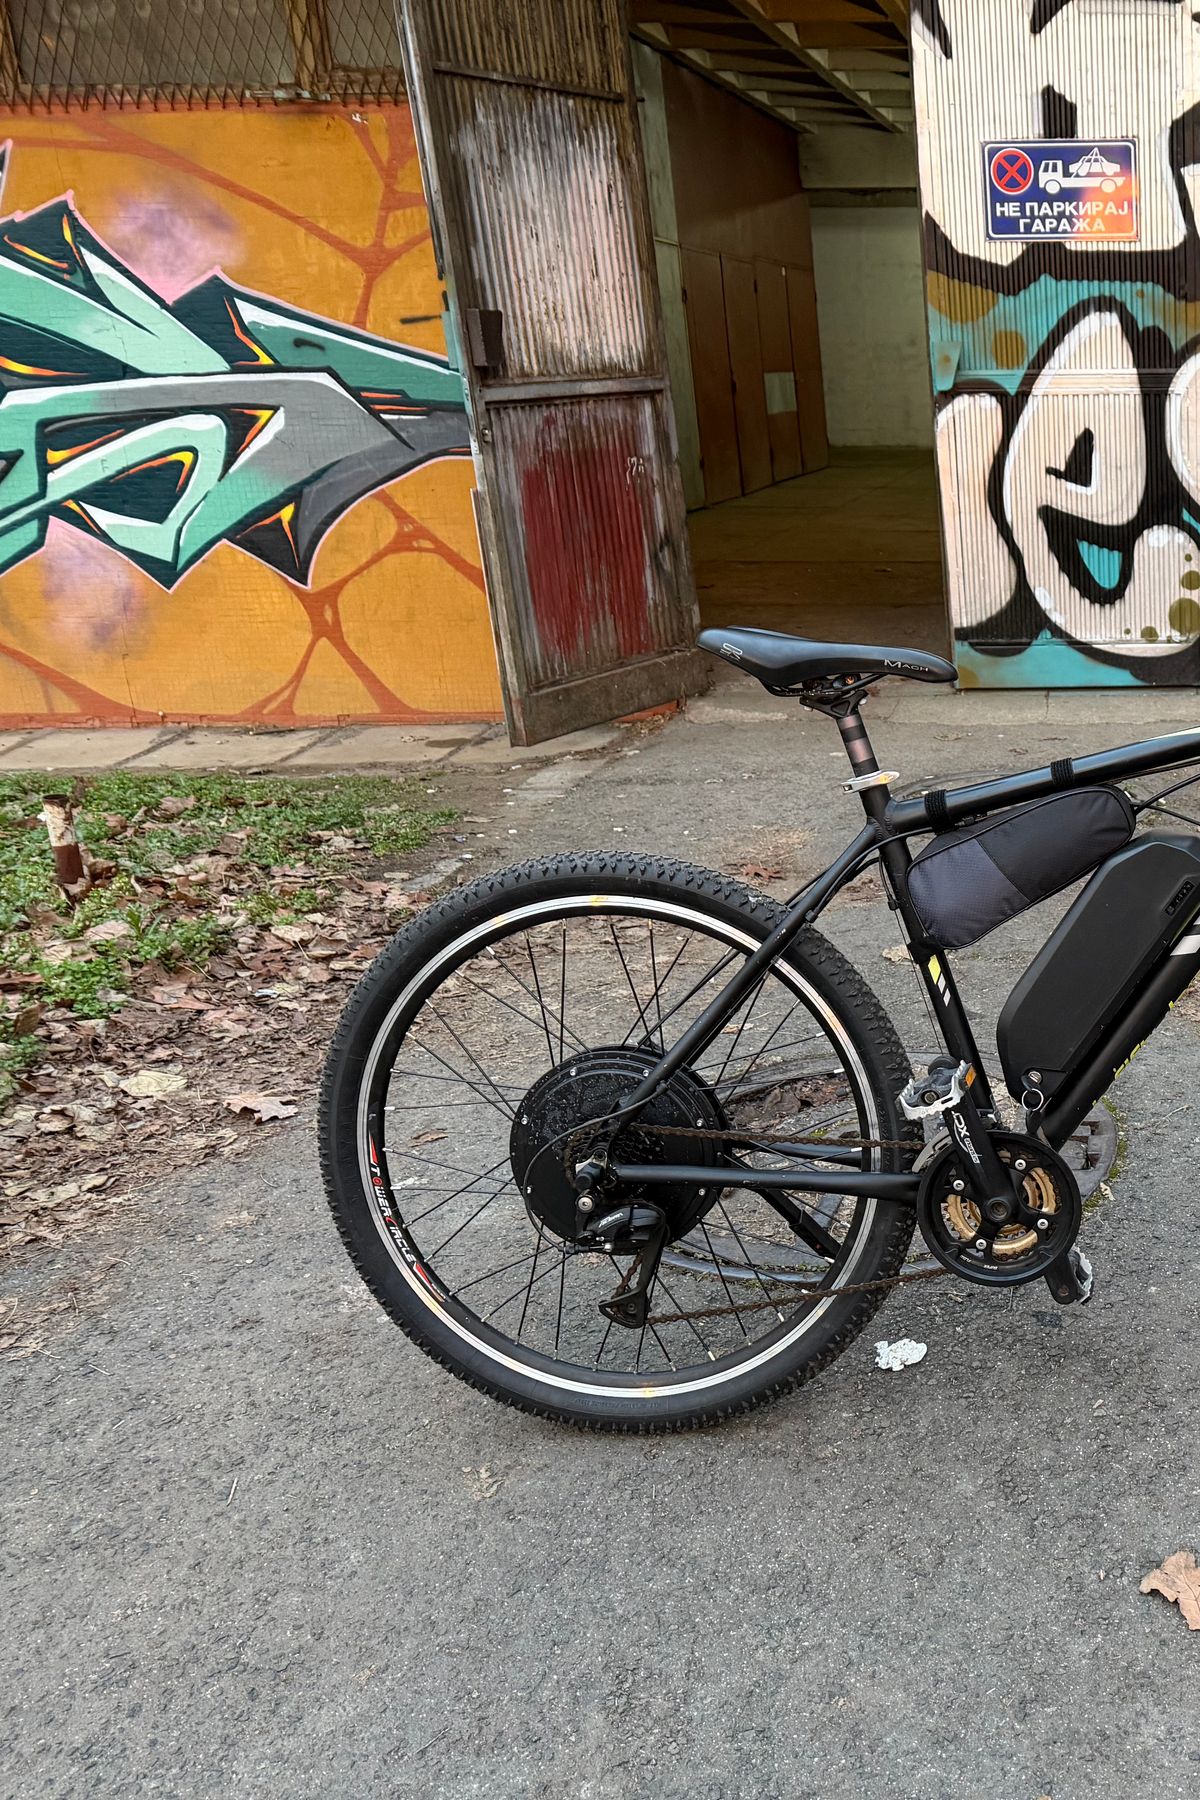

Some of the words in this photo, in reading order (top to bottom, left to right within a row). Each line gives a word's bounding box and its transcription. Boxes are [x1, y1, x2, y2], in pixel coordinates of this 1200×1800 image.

[995, 202, 1021, 217] НЕ
[1026, 201, 1128, 217] ПАРКИРАЈ
[1019, 218, 1106, 233] ГАРАЖА
